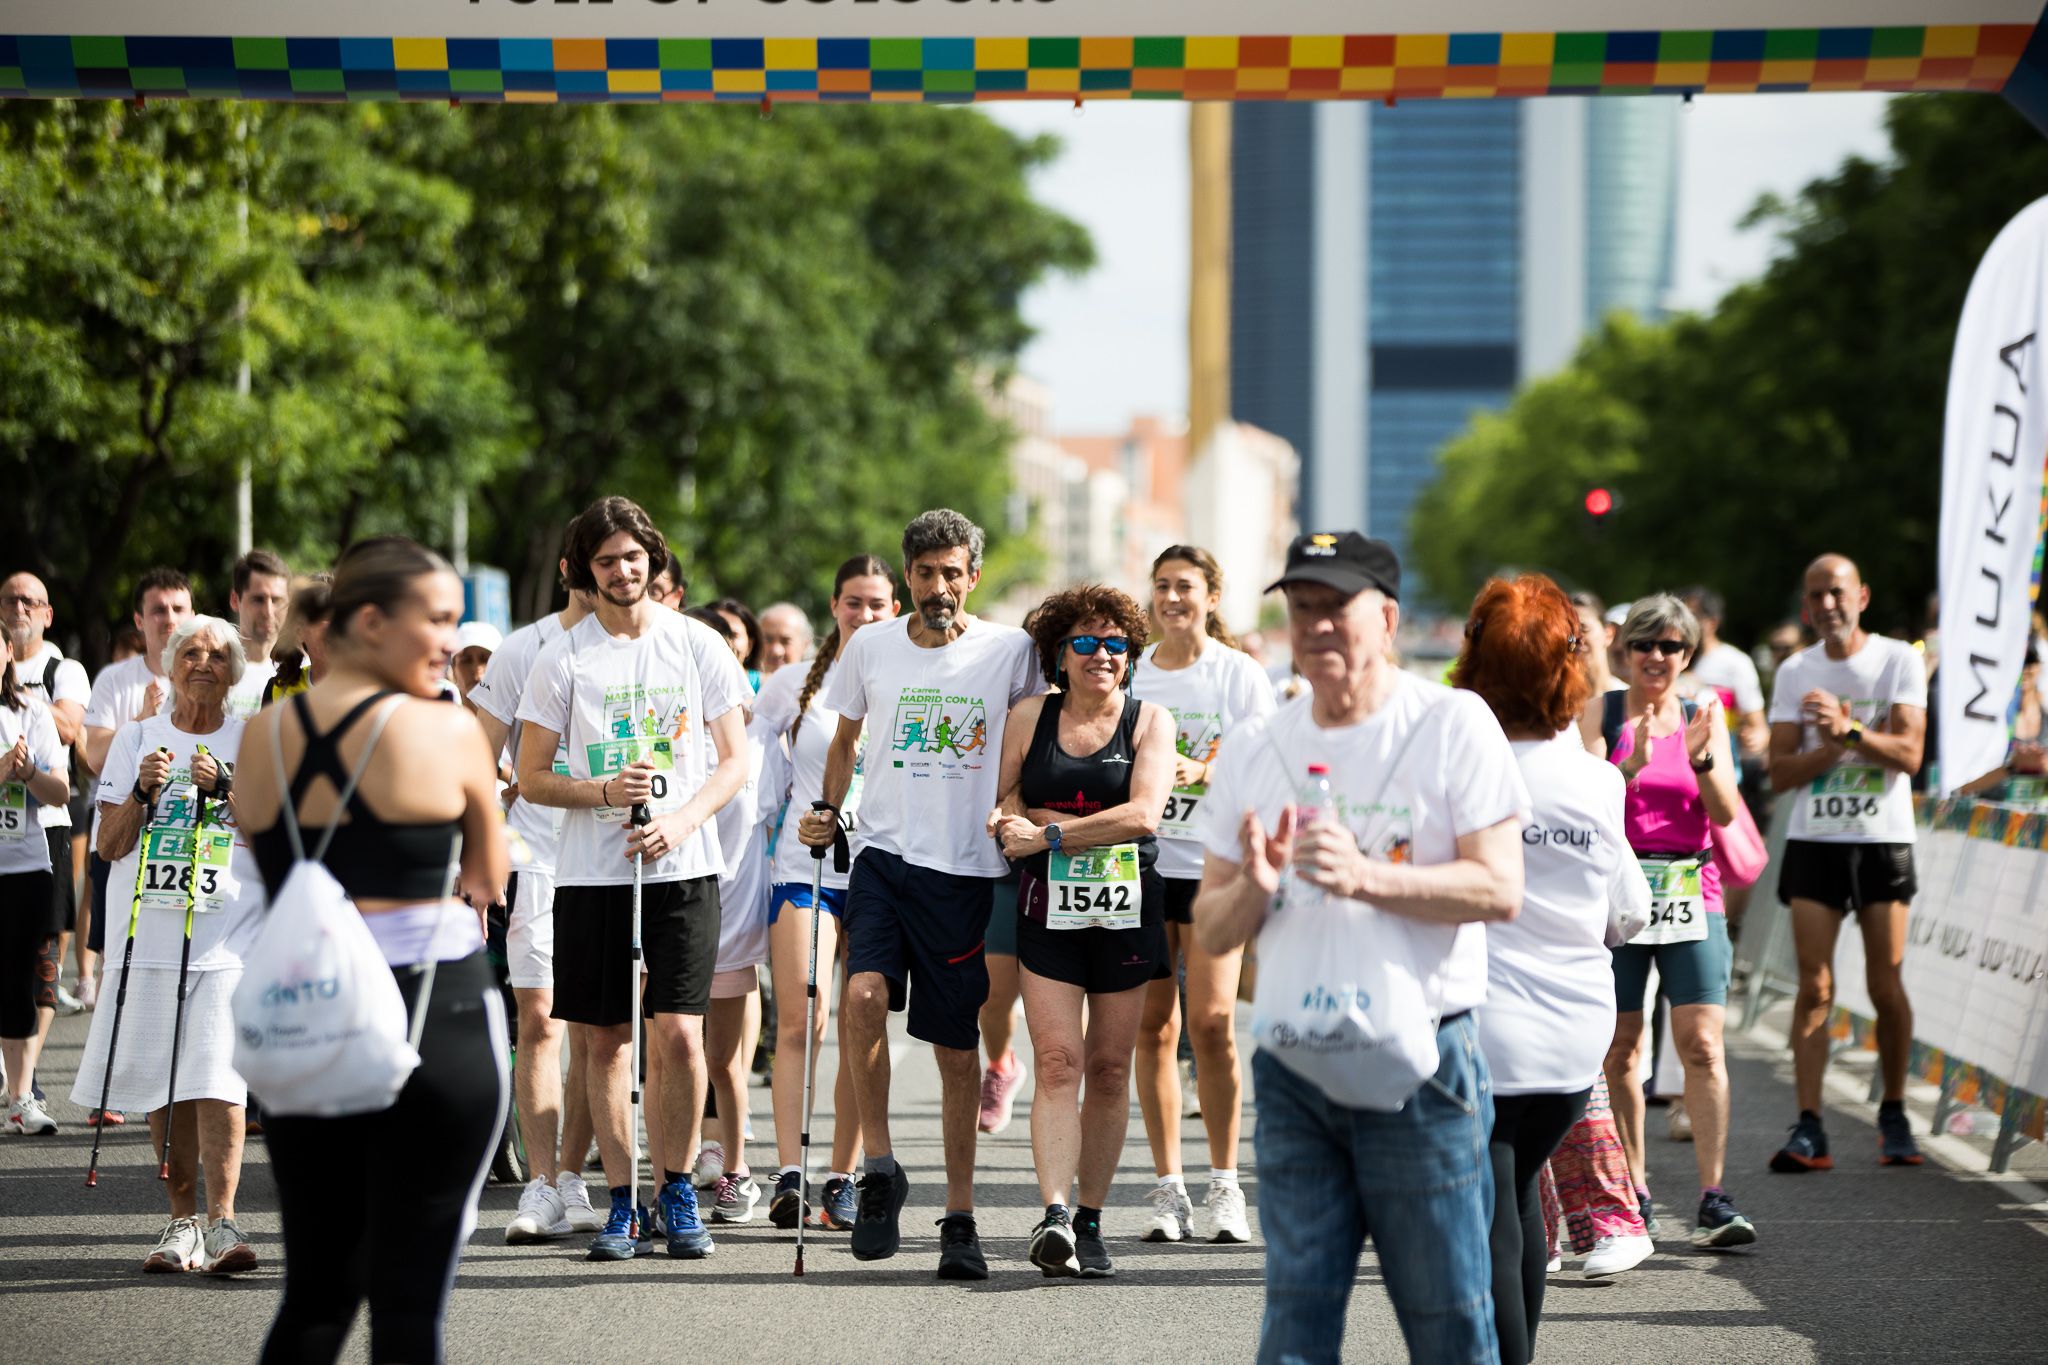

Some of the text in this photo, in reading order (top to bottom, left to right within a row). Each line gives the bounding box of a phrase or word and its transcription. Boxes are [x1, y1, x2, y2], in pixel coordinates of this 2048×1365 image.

[1963, 332, 2037, 723] MUKUA
[900, 695, 984, 705] MADRID CON LA
[1162, 796, 1198, 822] 87
[1813, 797, 1879, 818] 1036
[1522, 824, 1599, 852] Group
[1068, 856, 1120, 879] ELA
[1058, 885, 1131, 912] 1542
